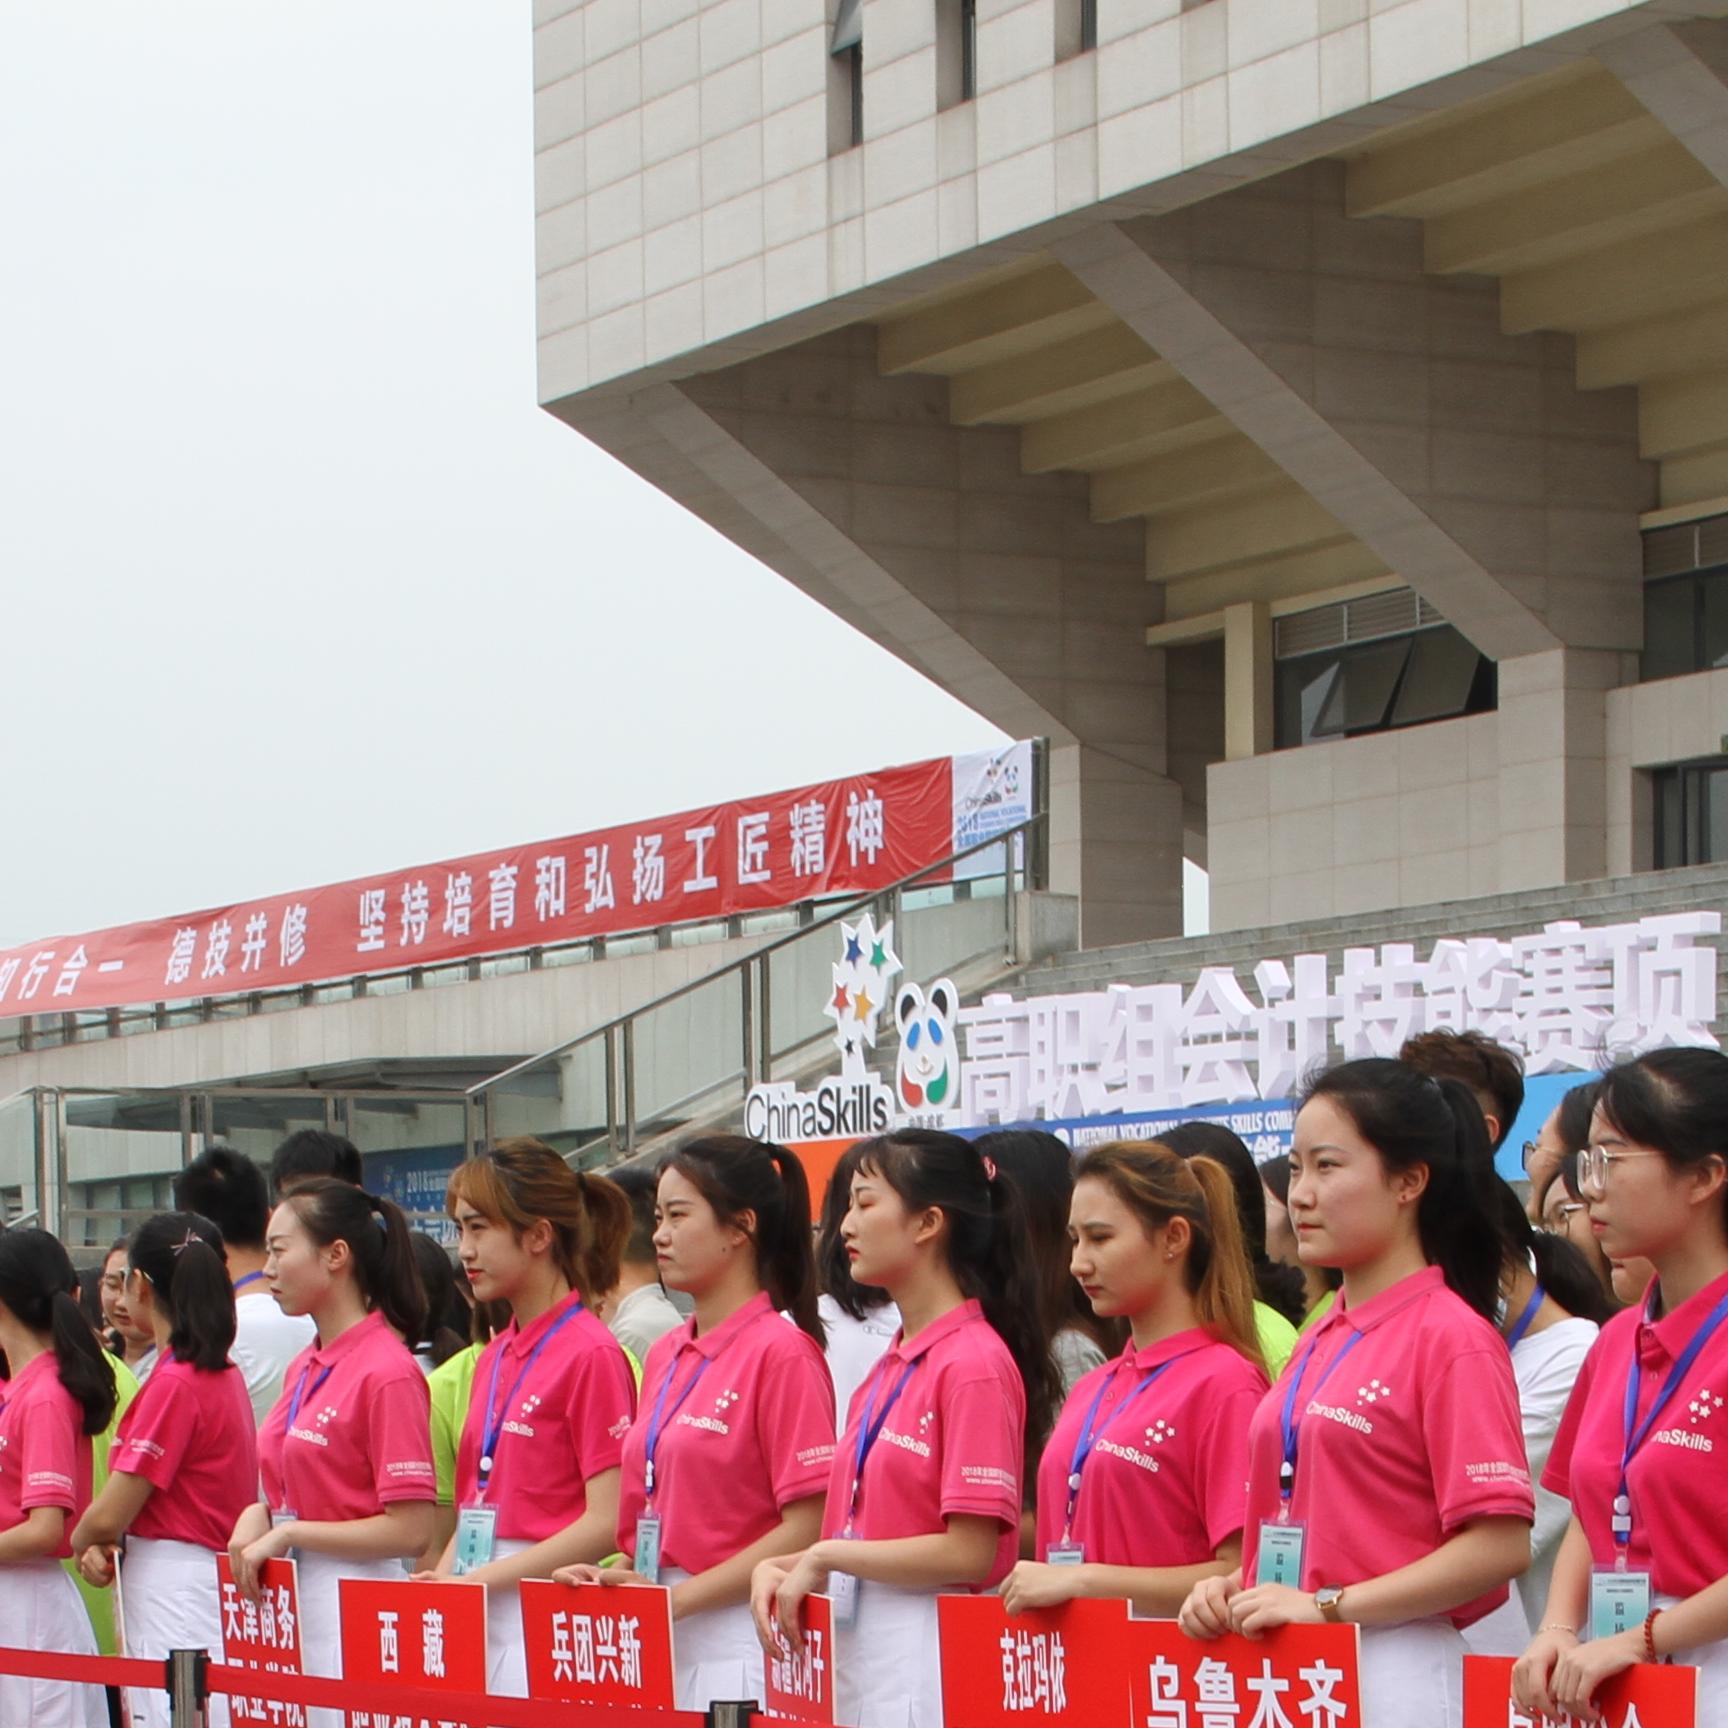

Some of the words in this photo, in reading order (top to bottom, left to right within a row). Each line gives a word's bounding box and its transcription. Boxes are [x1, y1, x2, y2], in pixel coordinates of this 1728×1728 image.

[164, 903, 308, 987] 德技并修
[356, 789, 885, 954] 坚持培育和弘扬工匠精神
[957, 911, 1723, 1128] 高职组会计技能赛项
[746, 1083, 889, 1140] ChinaSkills
[1231, 1111, 1264, 1132] SKILLS
[878, 1426, 931, 1458] ChinaSkills
[1305, 1400, 1373, 1435] ChinaSkills
[1095, 1439, 1160, 1473] ChinaSkills
[223, 1582, 295, 1650] 天津商务
[377, 1608, 445, 1678] 西藏
[551, 1610, 642, 1689] 兵团兴新
[999, 1627, 1067, 1714] 克拉玛依
